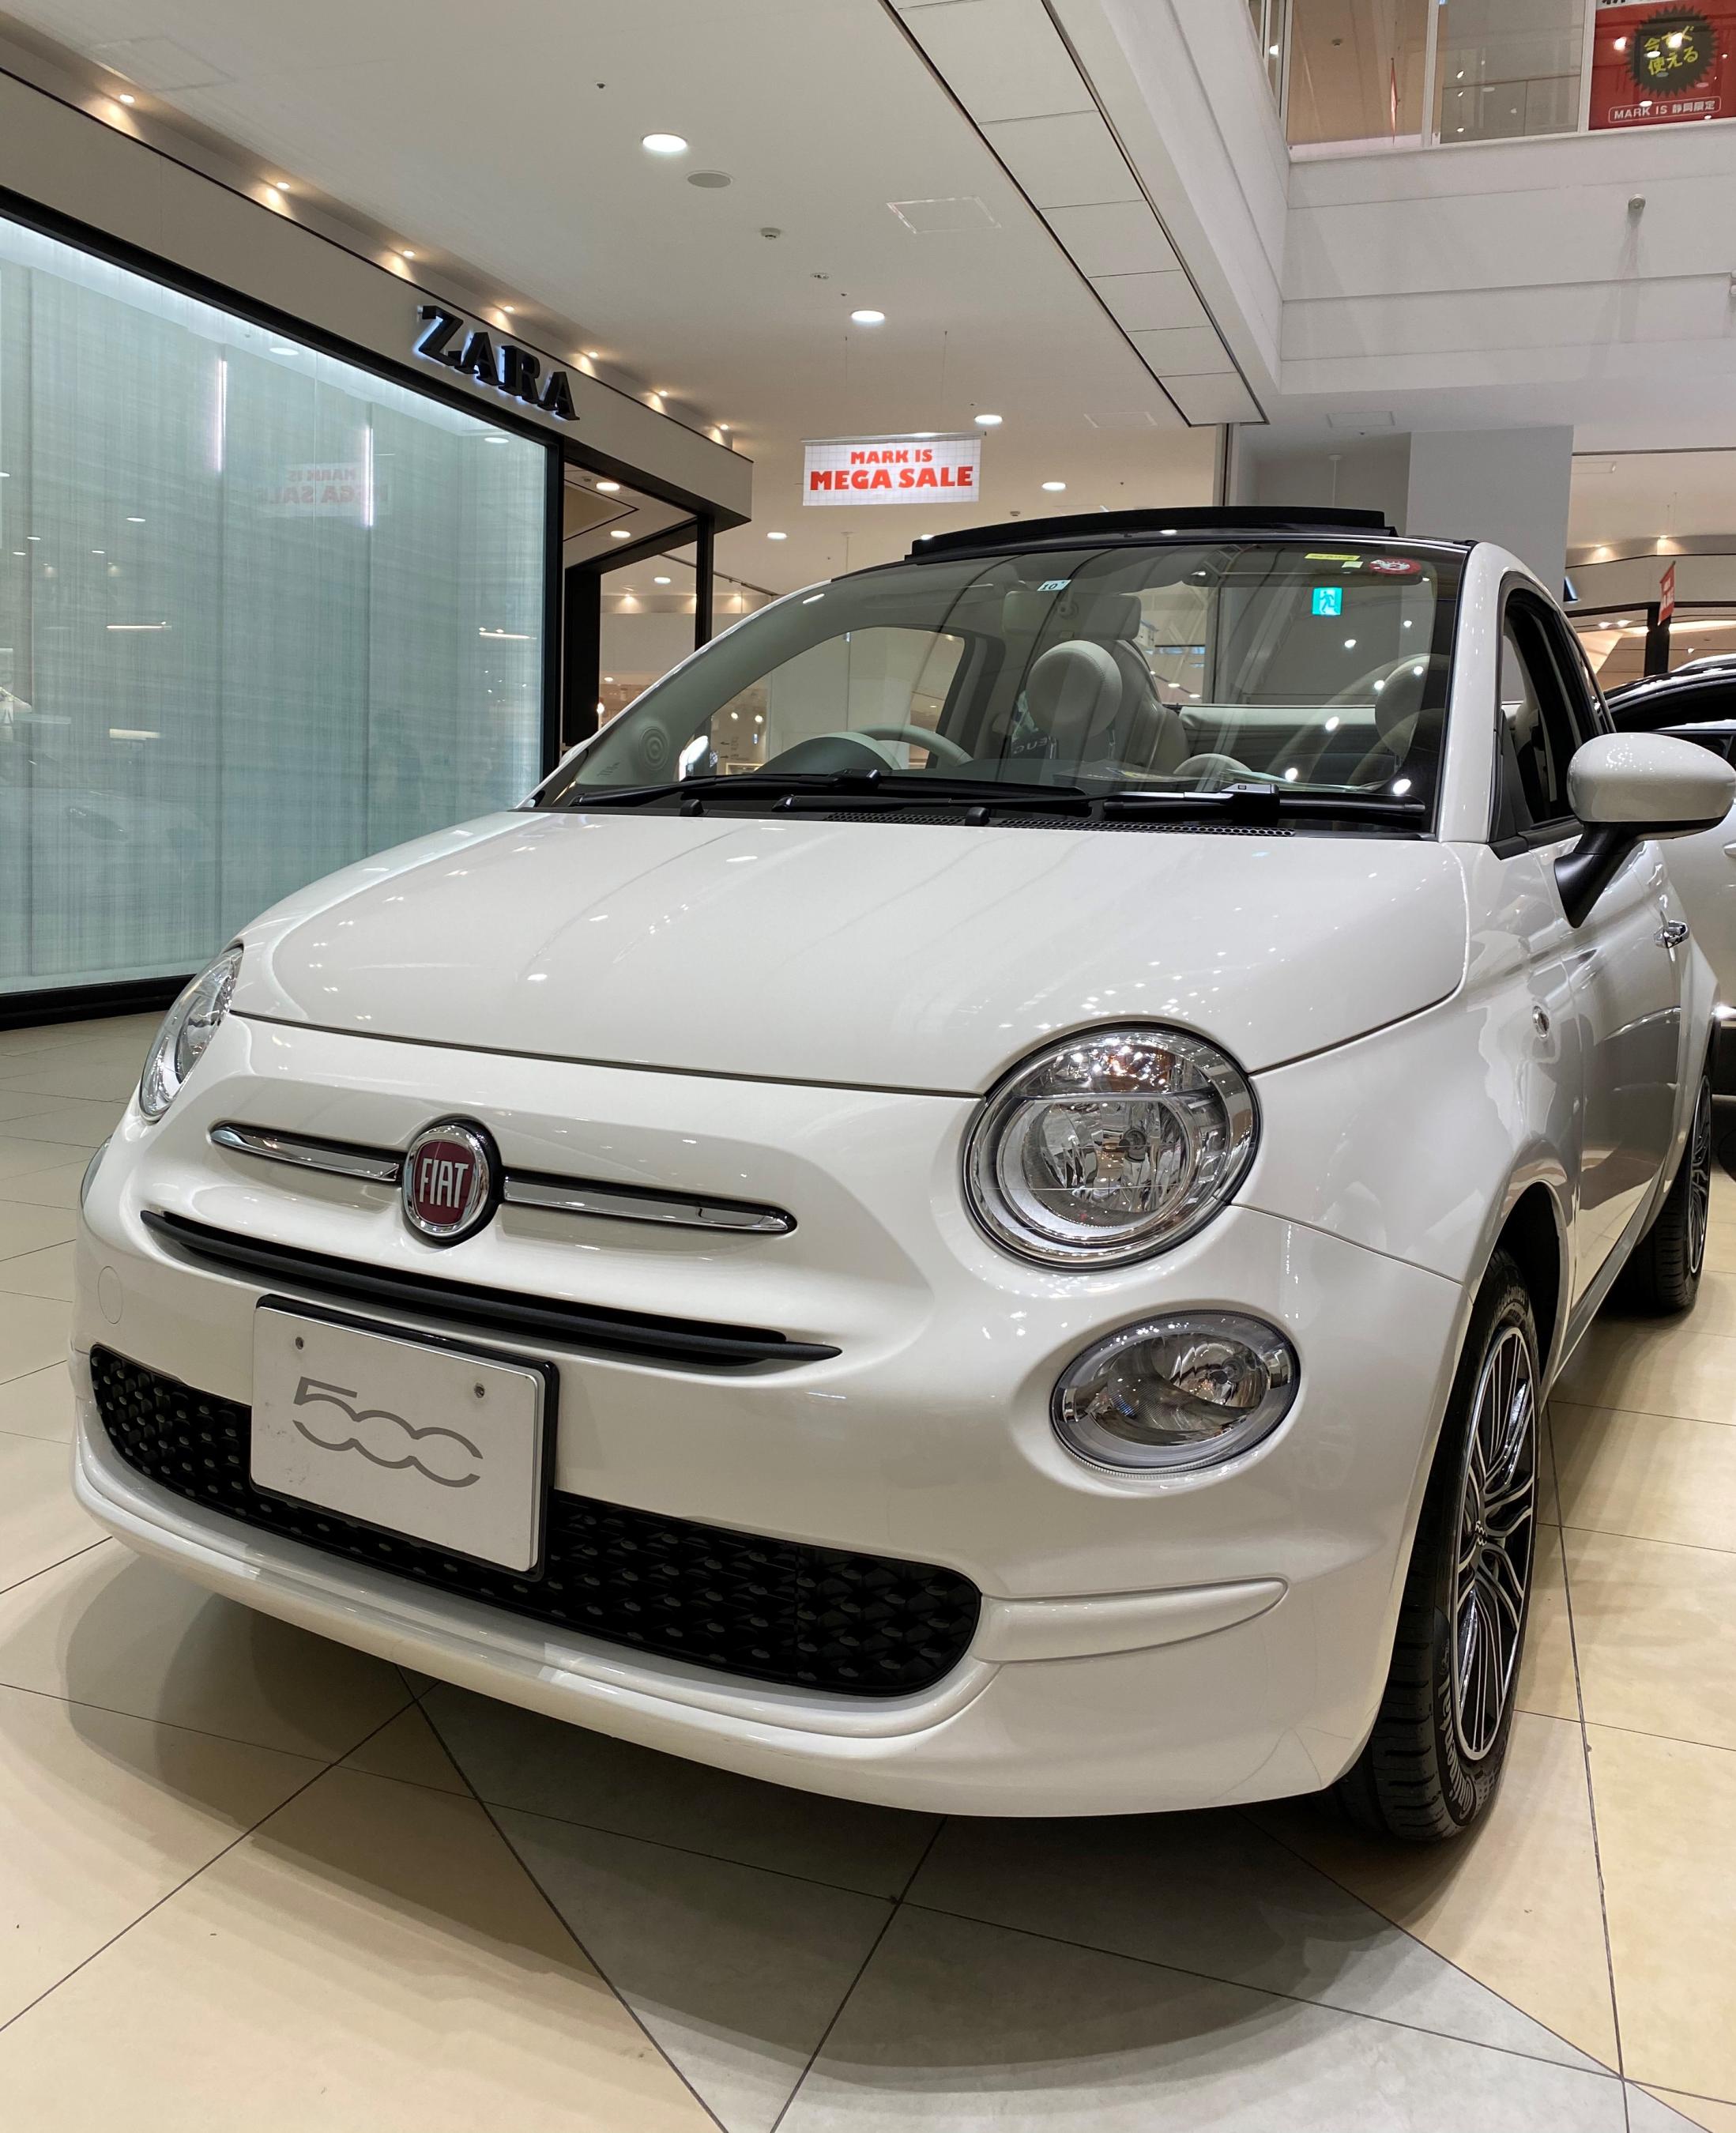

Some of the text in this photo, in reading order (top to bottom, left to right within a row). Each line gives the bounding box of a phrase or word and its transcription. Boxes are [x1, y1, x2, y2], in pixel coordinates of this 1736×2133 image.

[1648, 46, 1698, 75] 使える
[1614, 100, 1715, 119] MARK IS 静岡限定
[418, 305, 580, 420] ZARA
[850, 449, 932, 464] MARK IS
[810, 465, 973, 490] MEGA SALE
[419, 1158, 469, 1208] FIAT
[292, 1377, 484, 1488] 500
